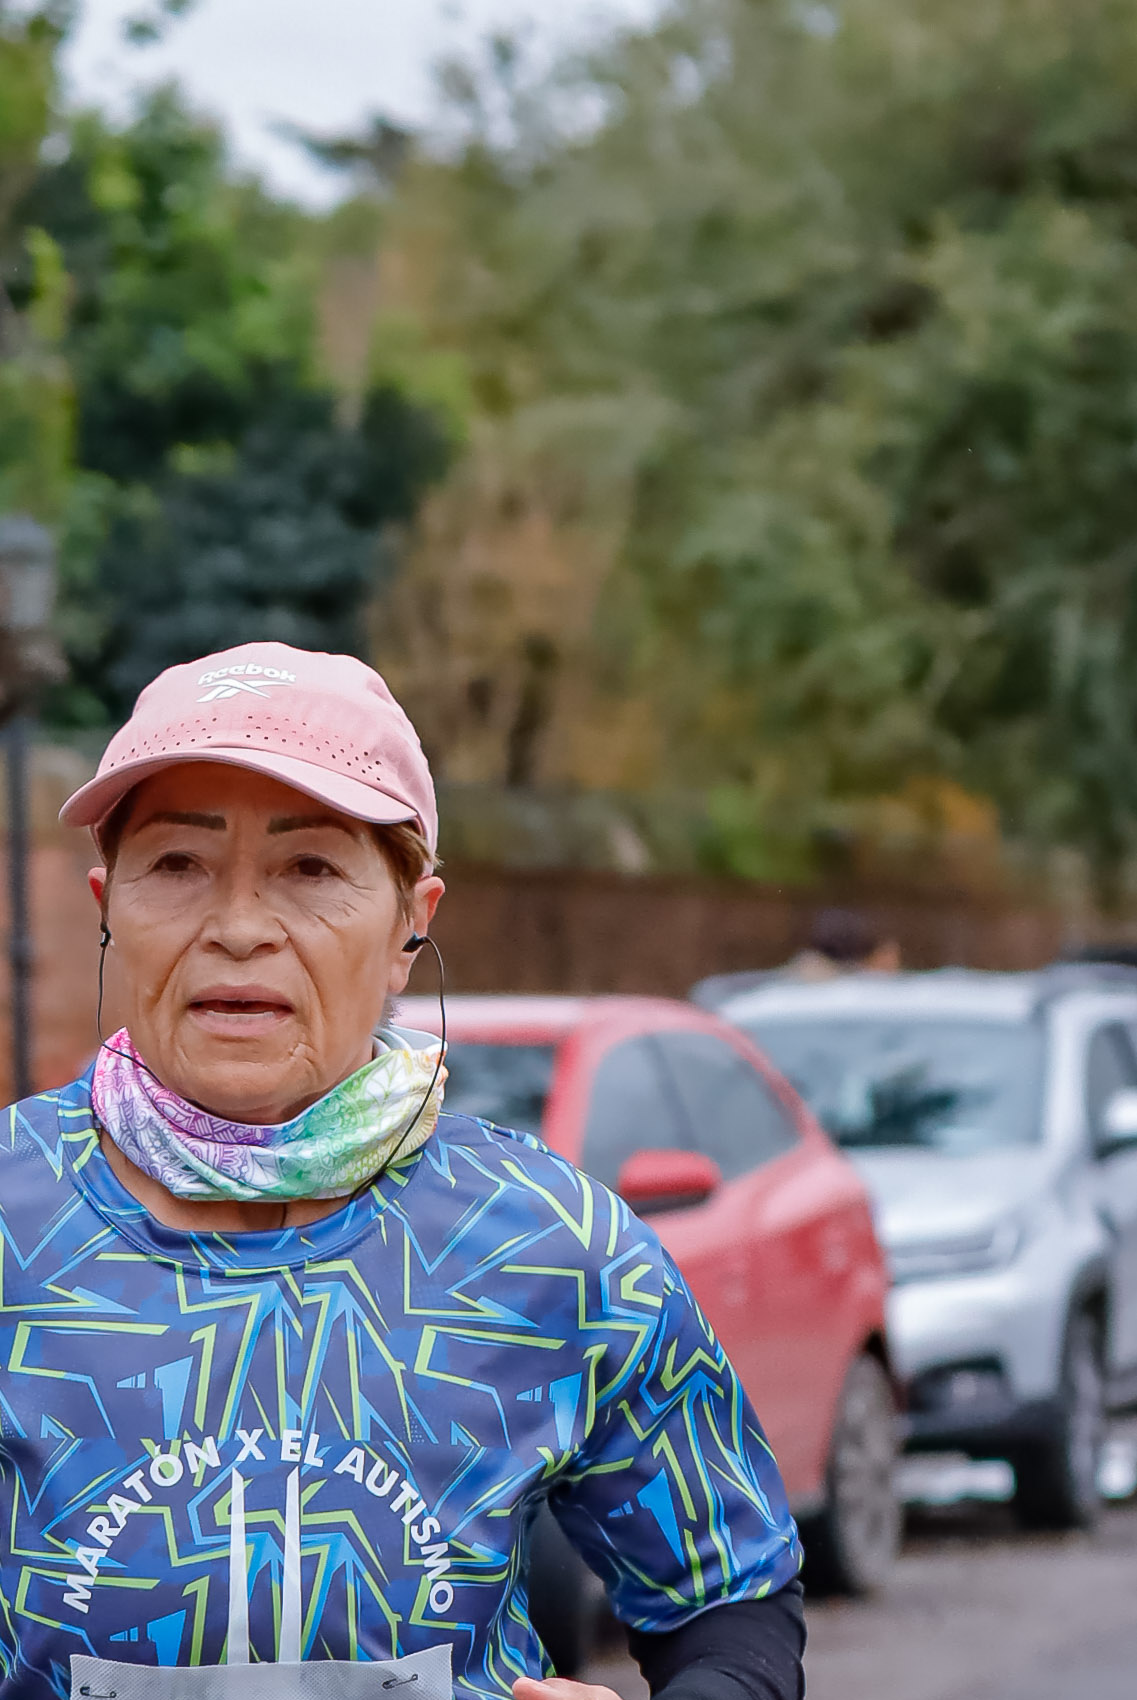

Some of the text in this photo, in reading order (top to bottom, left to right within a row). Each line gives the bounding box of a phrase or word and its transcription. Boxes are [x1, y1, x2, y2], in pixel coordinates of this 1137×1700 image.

[197, 663, 297, 685] Reebok
[63, 1428, 454, 1614] MARATÓN X EL AUTISMO
